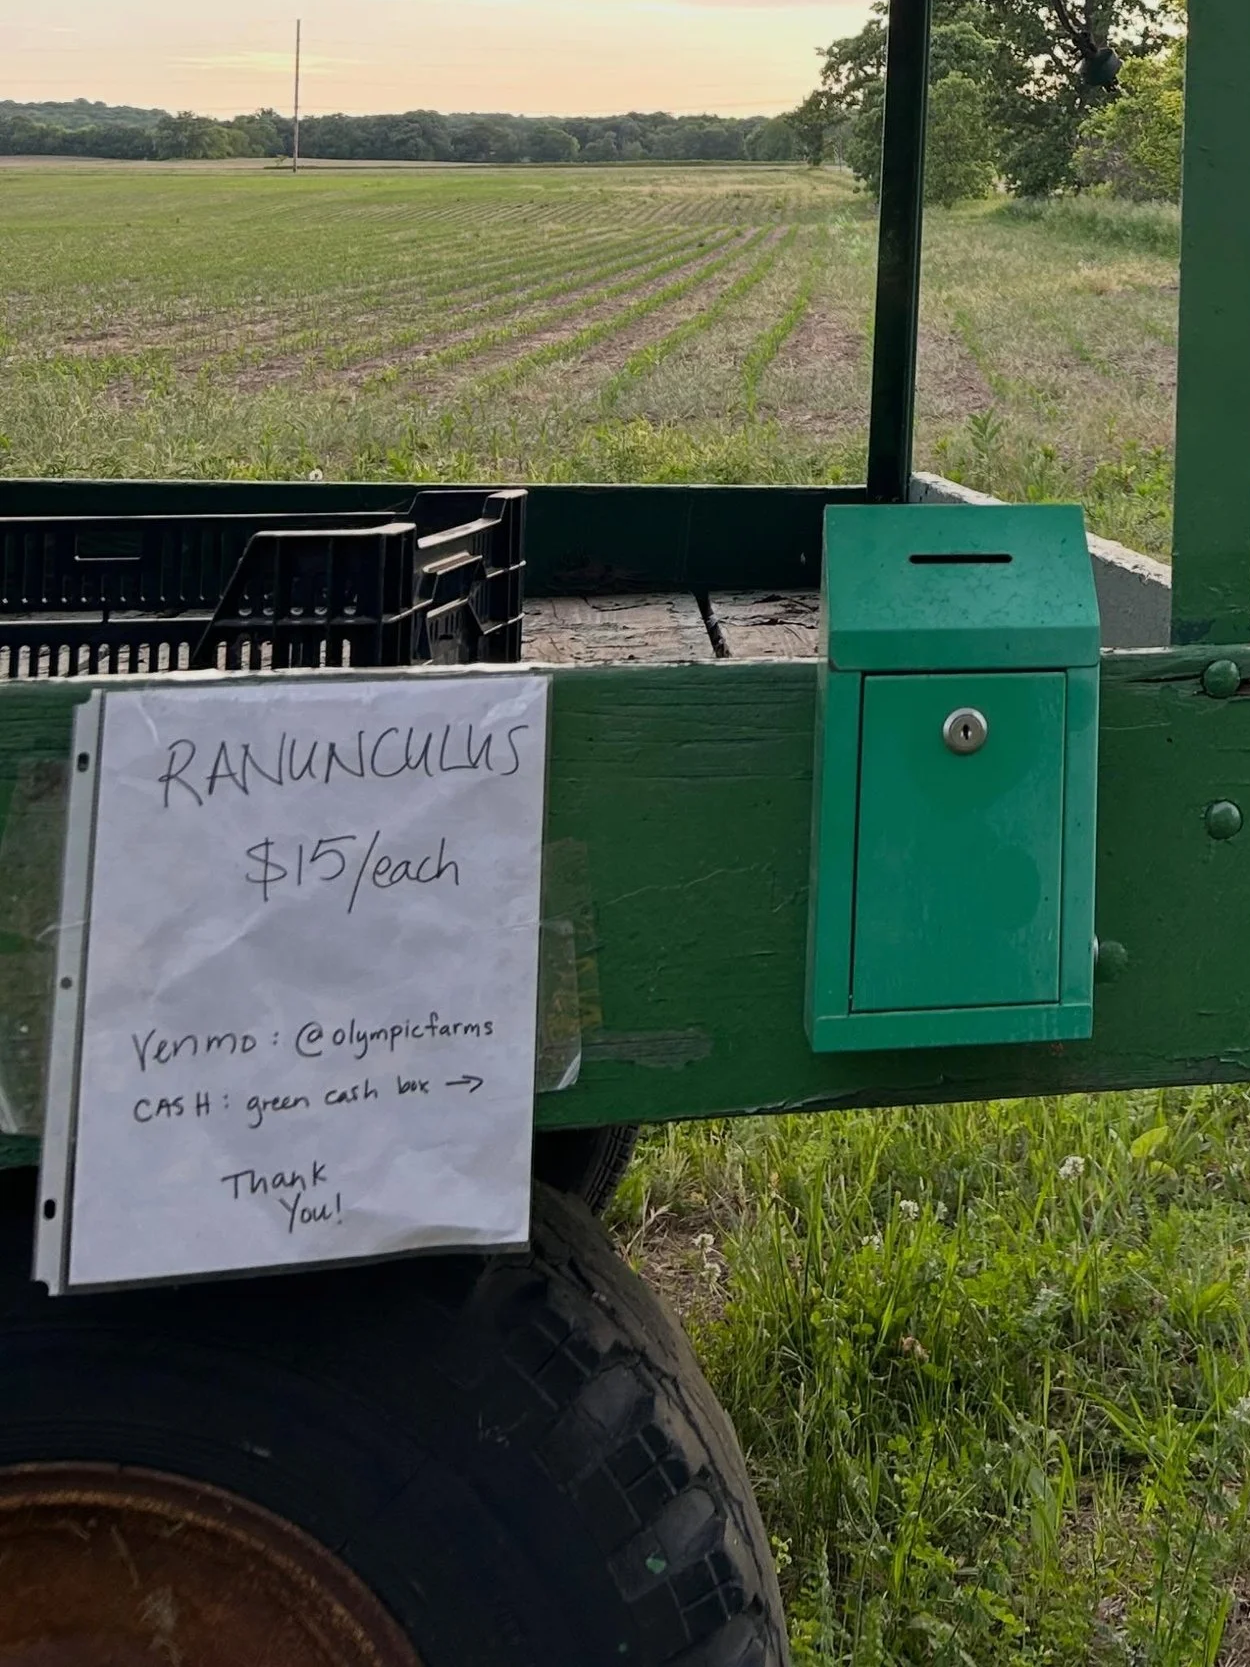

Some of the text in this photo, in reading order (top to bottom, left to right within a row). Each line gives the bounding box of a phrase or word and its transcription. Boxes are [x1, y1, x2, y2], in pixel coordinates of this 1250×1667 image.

[157, 724, 529, 809] RANUNCULUS
[245, 830, 459, 915] $15/each
[294, 1011, 494, 1061] @olympicfarms
[246, 1096, 311, 1130] green
[323, 1085, 379, 1107] cash
[396, 1075, 430, 1095] box
[220, 1159, 328, 1200] Thank
[278, 1192, 343, 1235] You!
